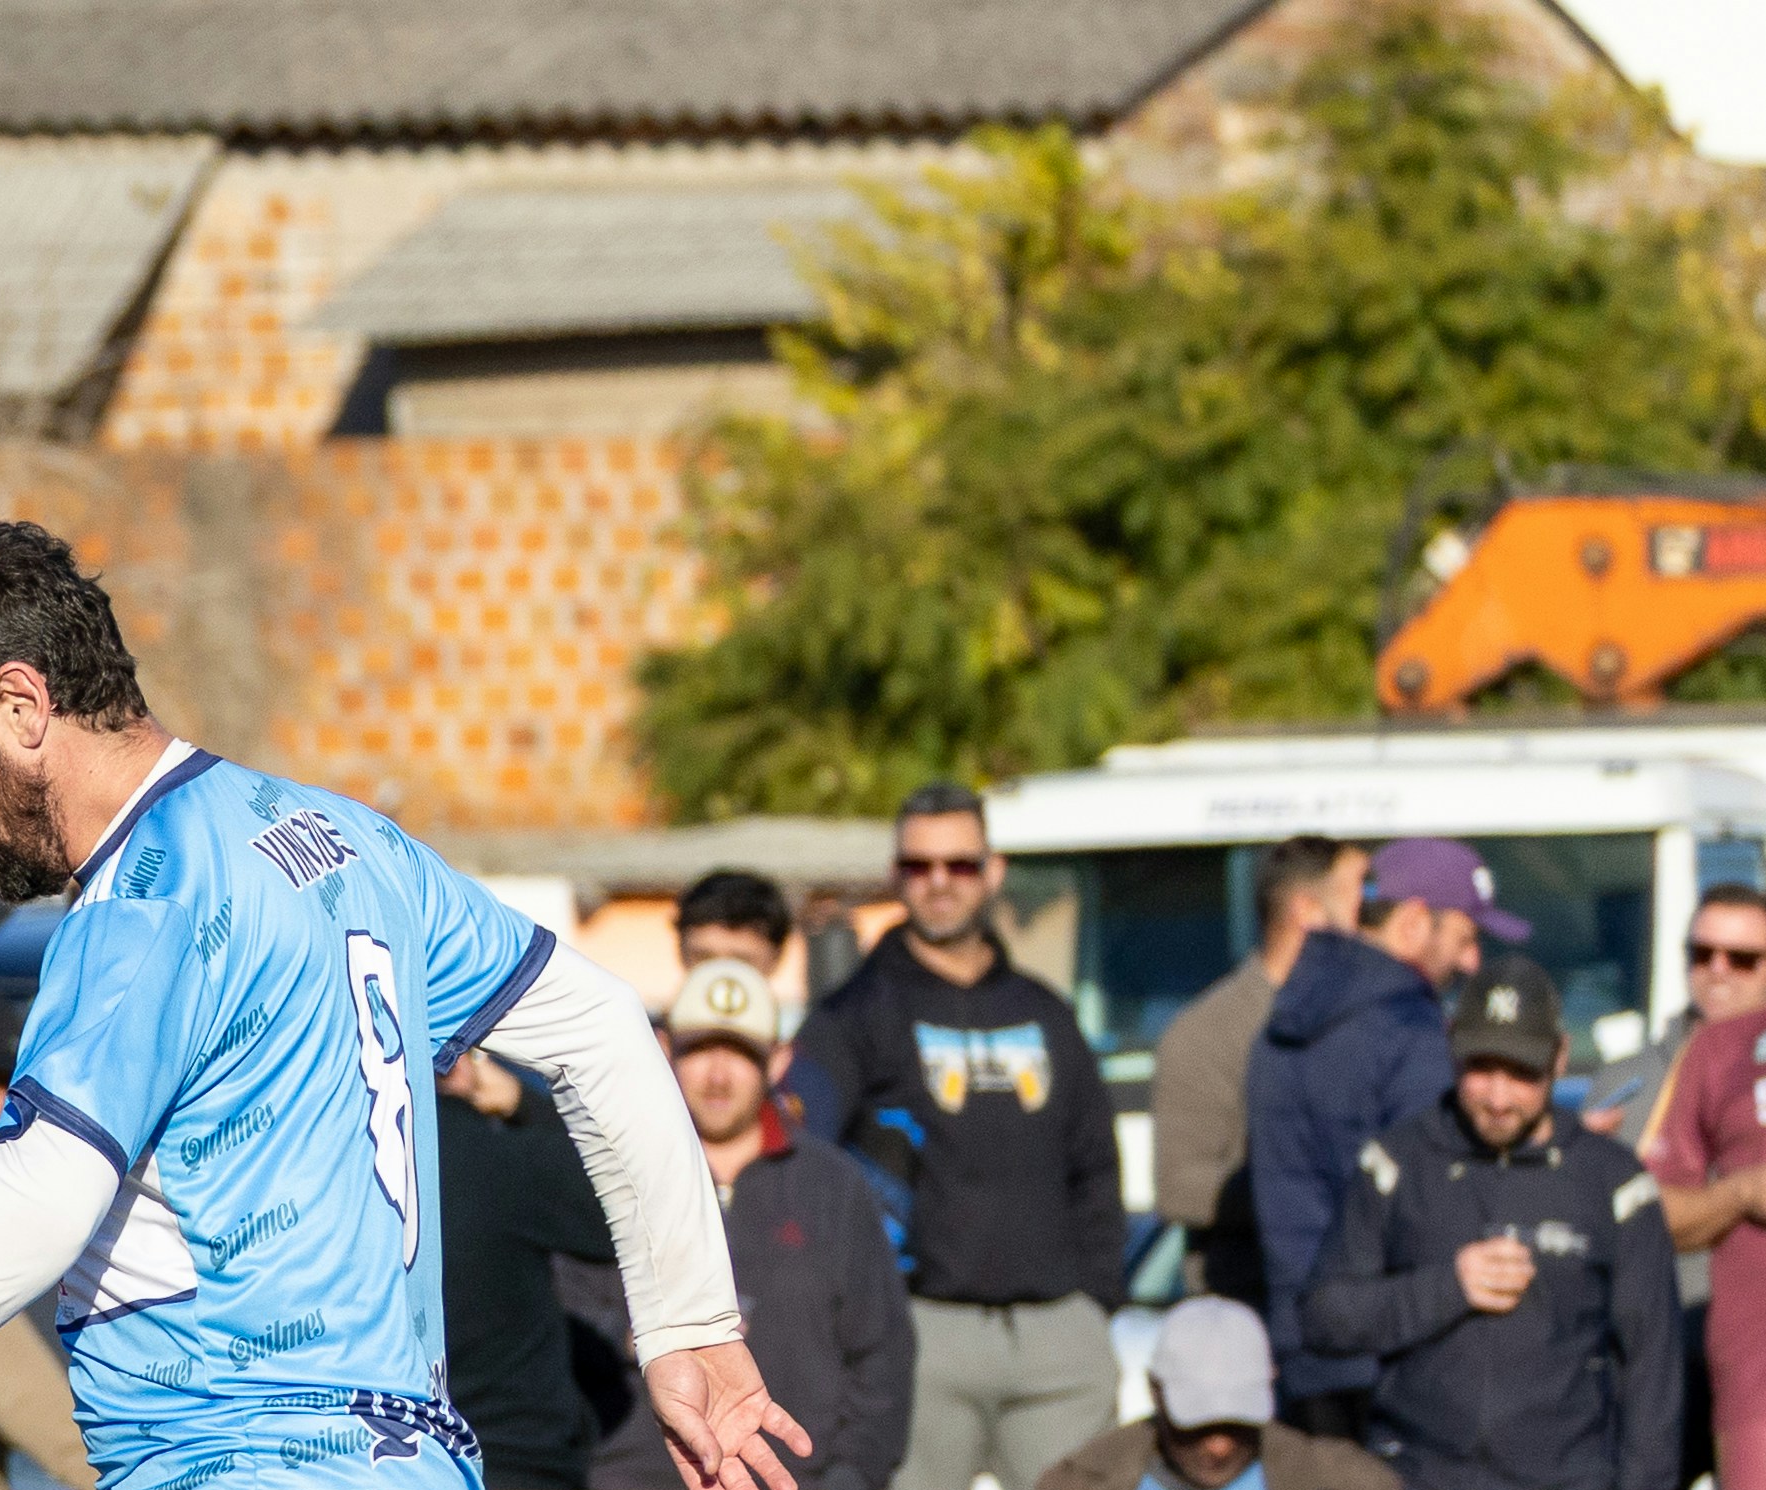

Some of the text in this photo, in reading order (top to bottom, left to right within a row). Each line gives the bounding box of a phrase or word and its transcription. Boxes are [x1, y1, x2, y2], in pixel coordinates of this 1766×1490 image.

[180, 1101, 276, 1175] Quilmes
[346, 928, 420, 1274] 8
[209, 1198, 299, 1273] Quilmes
[228, 1309, 326, 1372] Quilmes
